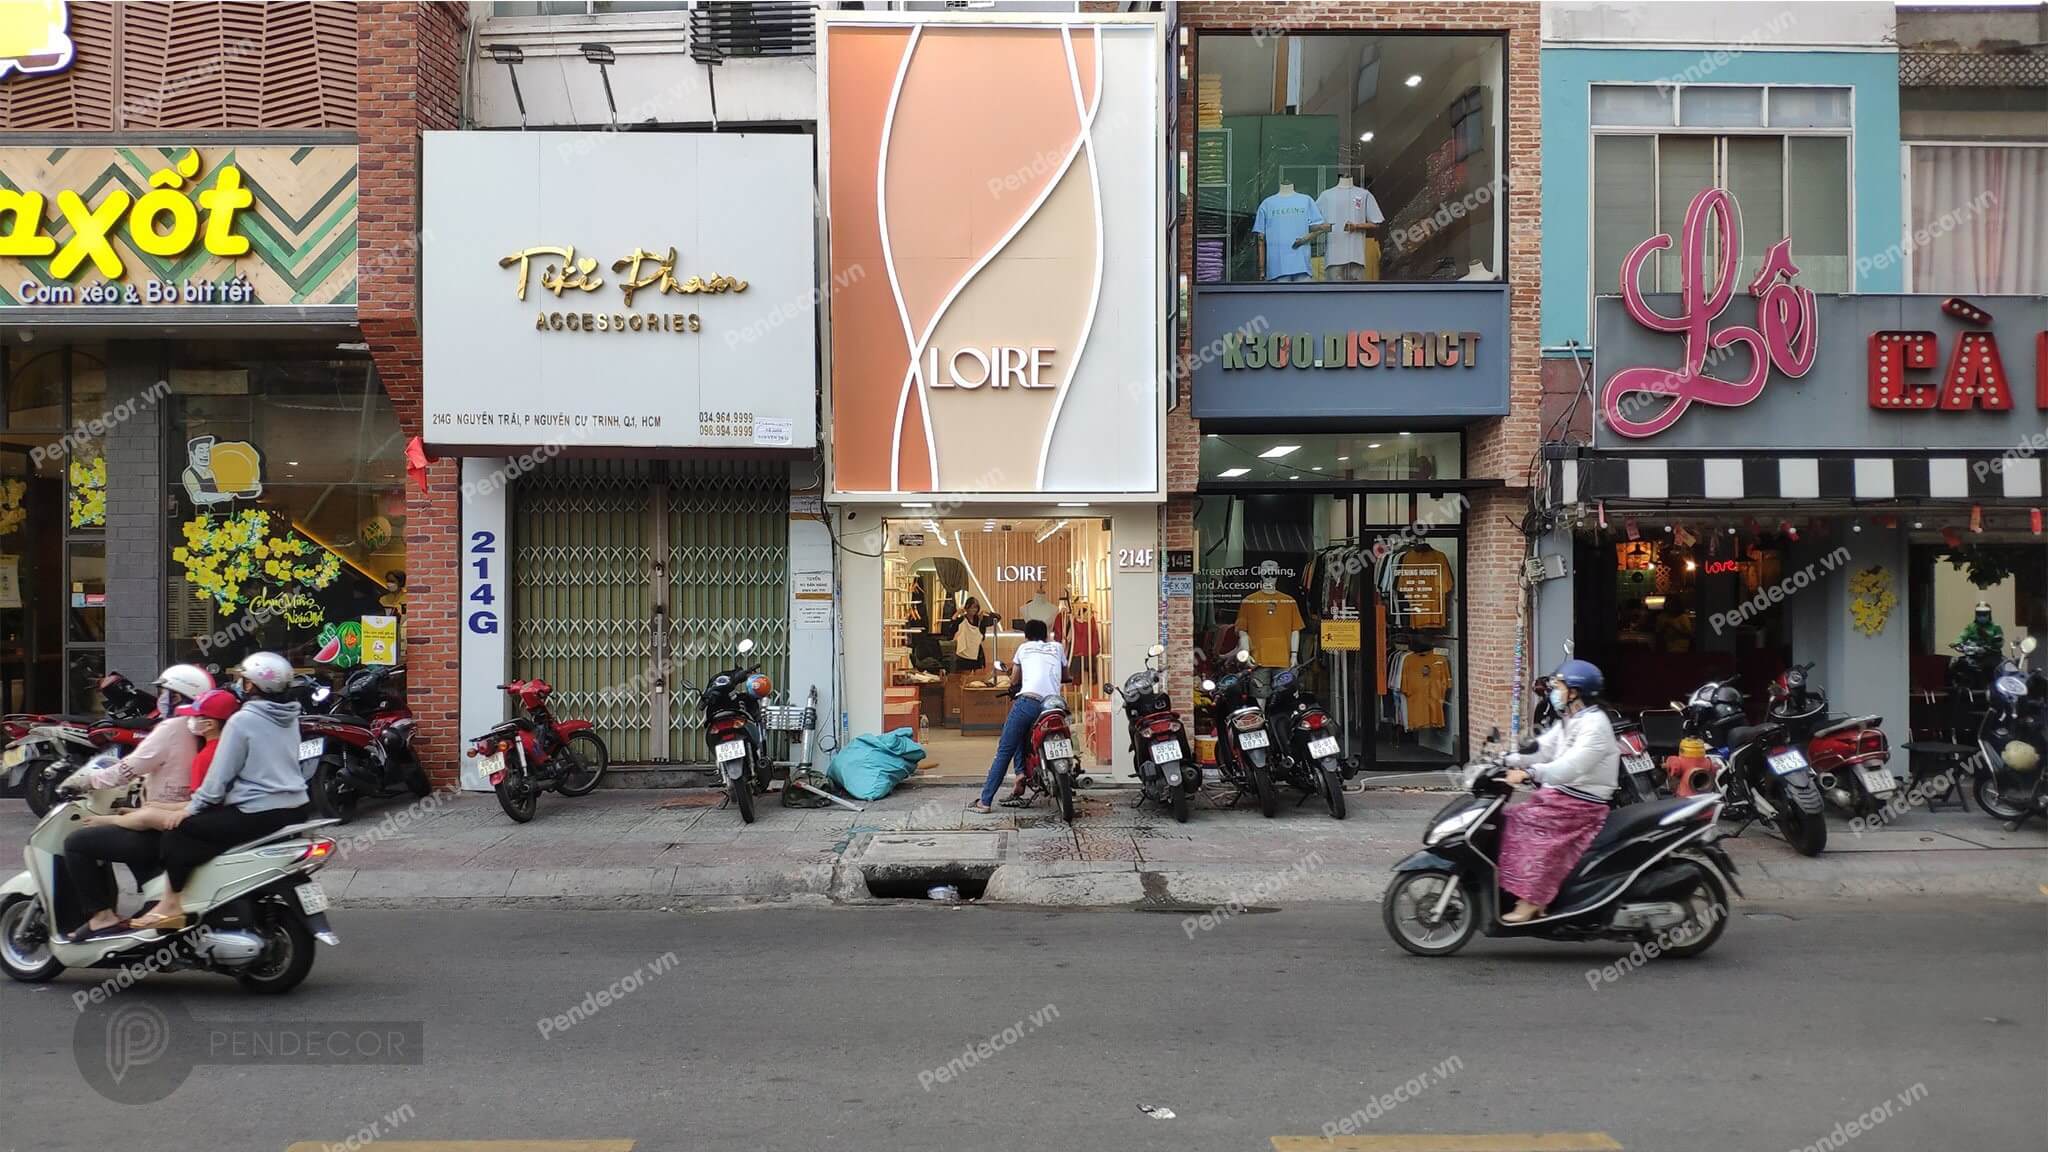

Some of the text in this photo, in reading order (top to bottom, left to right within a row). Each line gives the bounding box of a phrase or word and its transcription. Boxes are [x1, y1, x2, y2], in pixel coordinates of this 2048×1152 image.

[498, 245, 604, 300] Tiki
[80, 280, 119, 303] xèo
[123, 284, 140, 303] &
[146, 279, 178, 303] Bò
[183, 278, 215, 302] bít
[219, 273, 253, 302] tết
[536, 311, 702, 333] ACCESSORIES
[1867, 298, 2015, 411] CÀ
[929, 346, 1057, 390] LOIRE
[433, 413, 451, 424] 214G
[525, 415, 530, 425] P
[642, 416, 661, 427] HCM
[699, 411, 753, 424] 034.964.9999
[1119, 548, 1154, 568] 214F
[1166, 554, 1192, 568] 14E
[1704, 559, 1738, 575] love
[996, 565, 1048, 583] LOIRE
[1250, 566, 1296, 578] Clothing,
[468, 530, 498, 635] 214G
